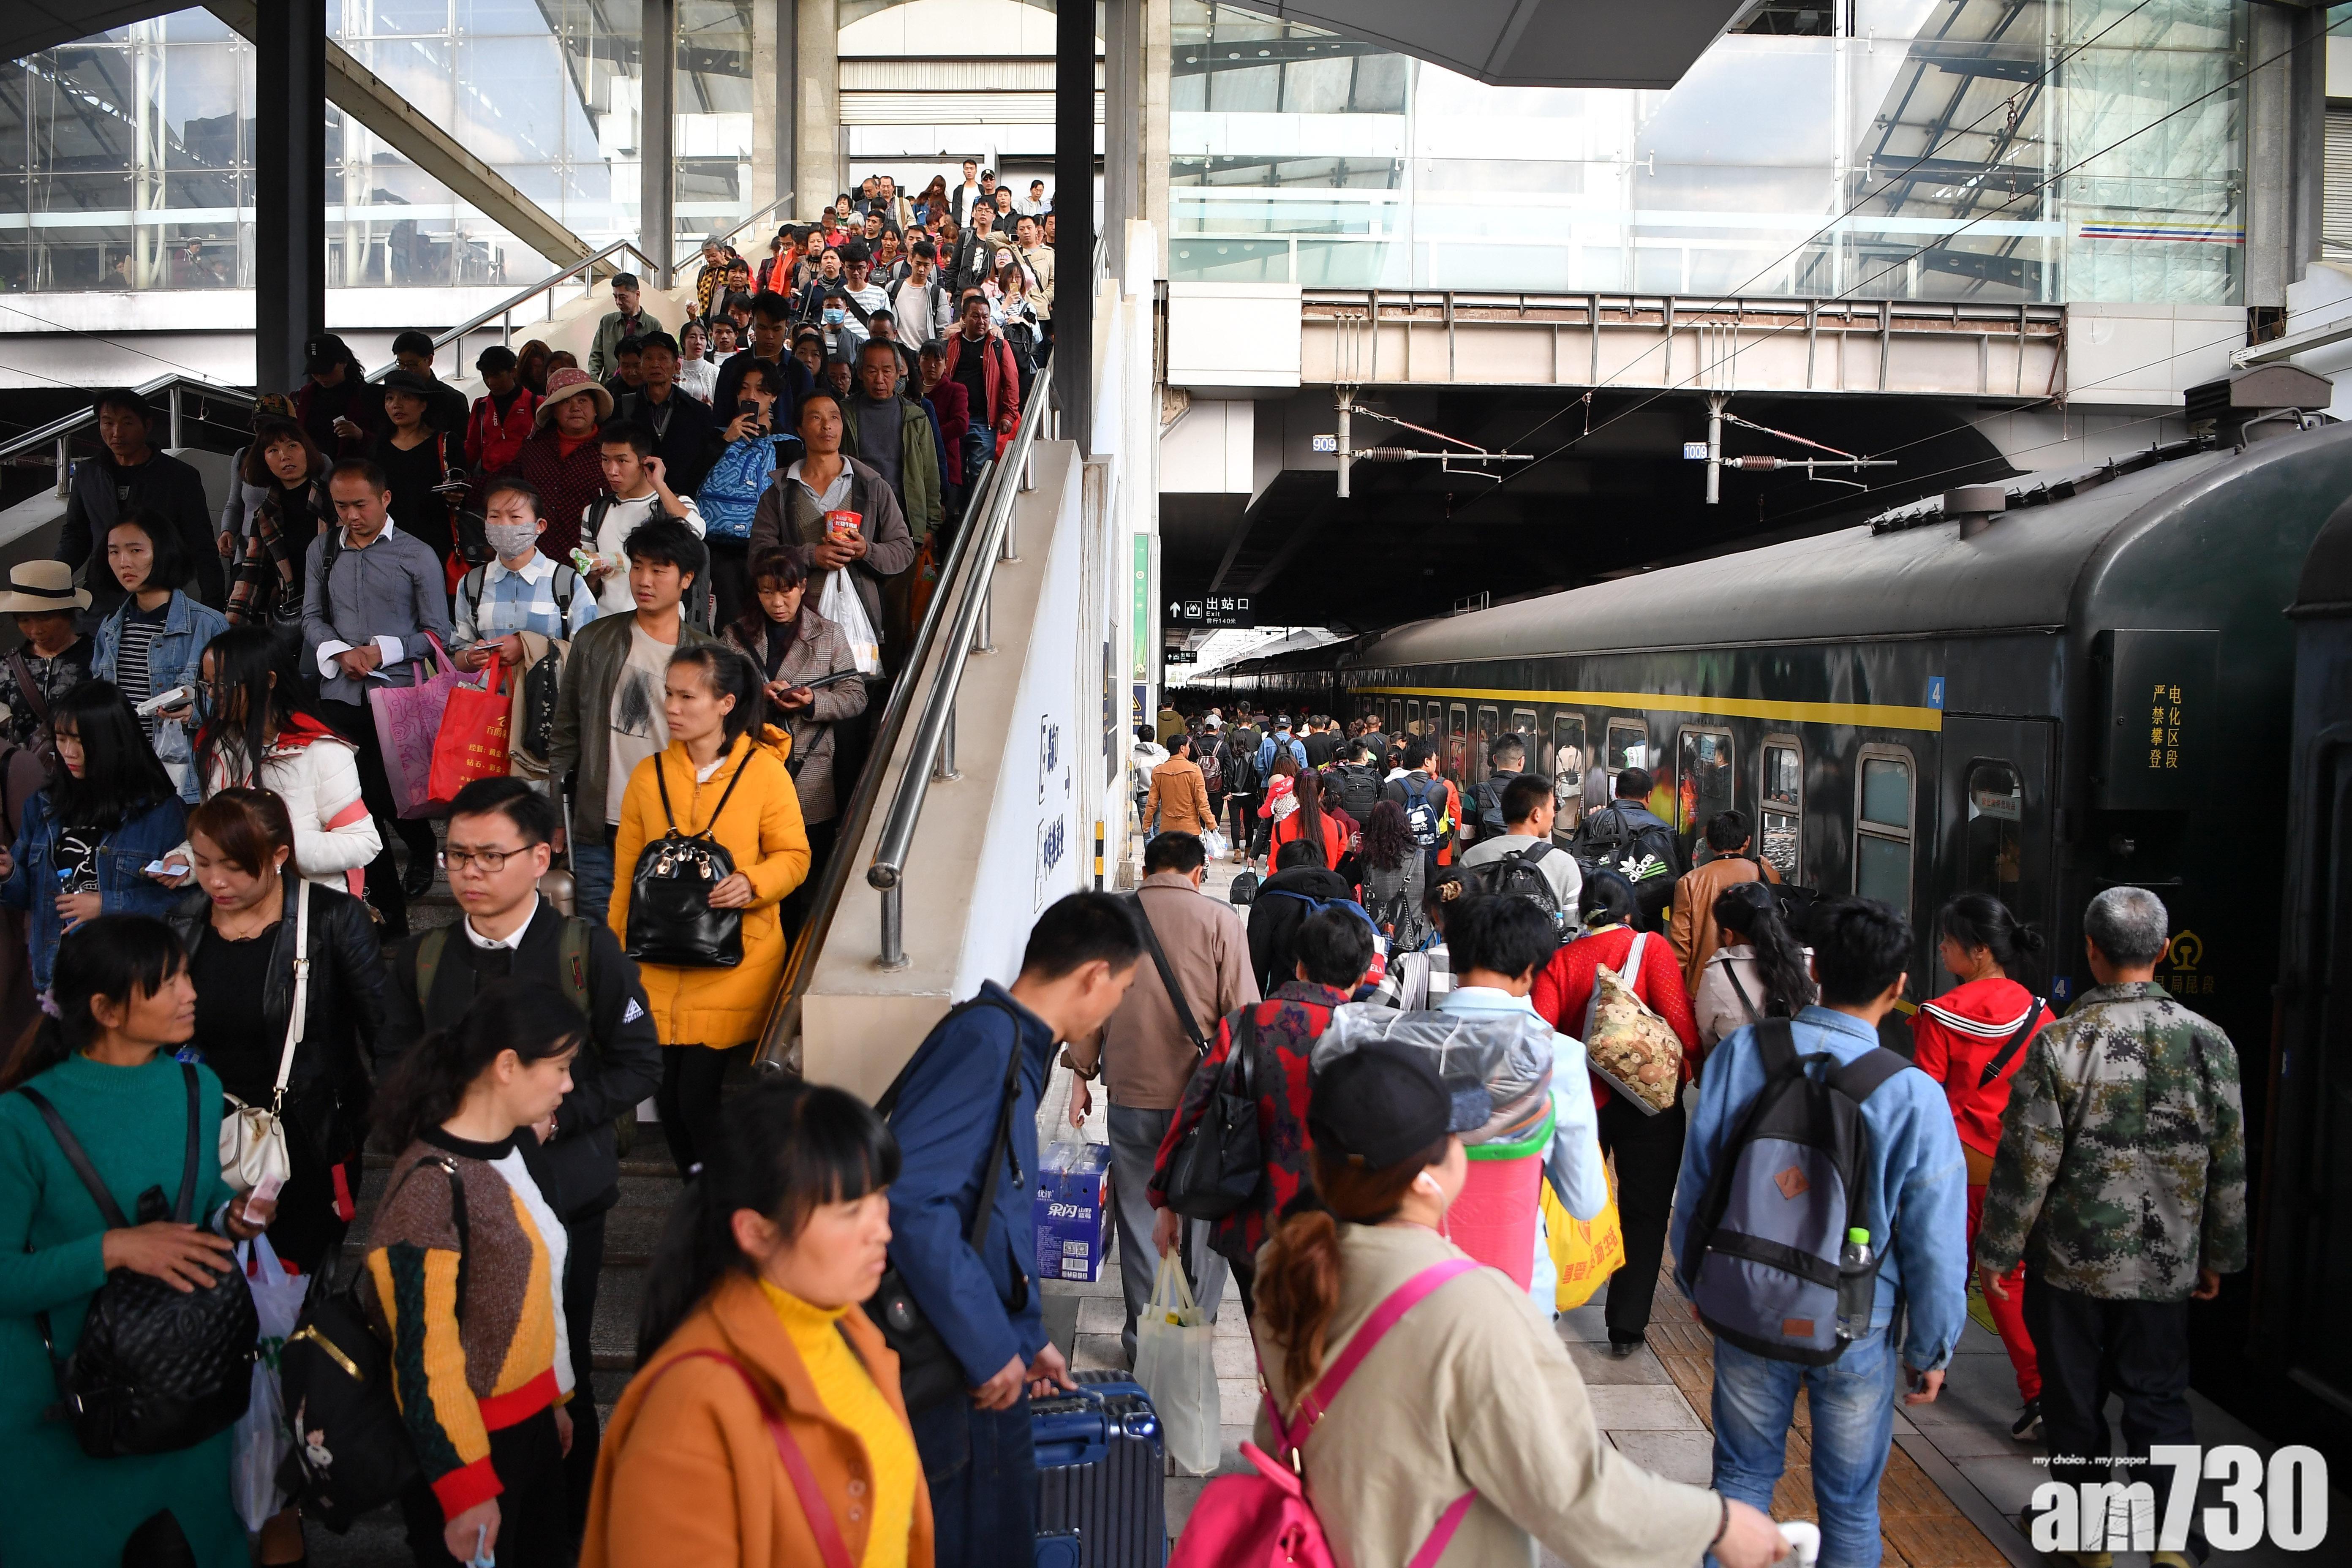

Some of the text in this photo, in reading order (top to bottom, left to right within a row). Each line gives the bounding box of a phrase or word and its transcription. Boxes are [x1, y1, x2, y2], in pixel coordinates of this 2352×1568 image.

[1313, 438, 1337, 451] 909
[1685, 446, 1707, 458] 1009
[1206, 596, 1249, 610] 出站口
[1932, 683, 1940, 704] 4
[2148, 684, 2166, 768] 严禁攀登
[2165, 685, 2181, 768] 电化区段
[1629, 854, 1655, 882] adidas
[2055, 980, 2066, 997] 4
[1047, 1203, 1077, 1217] 果闪
